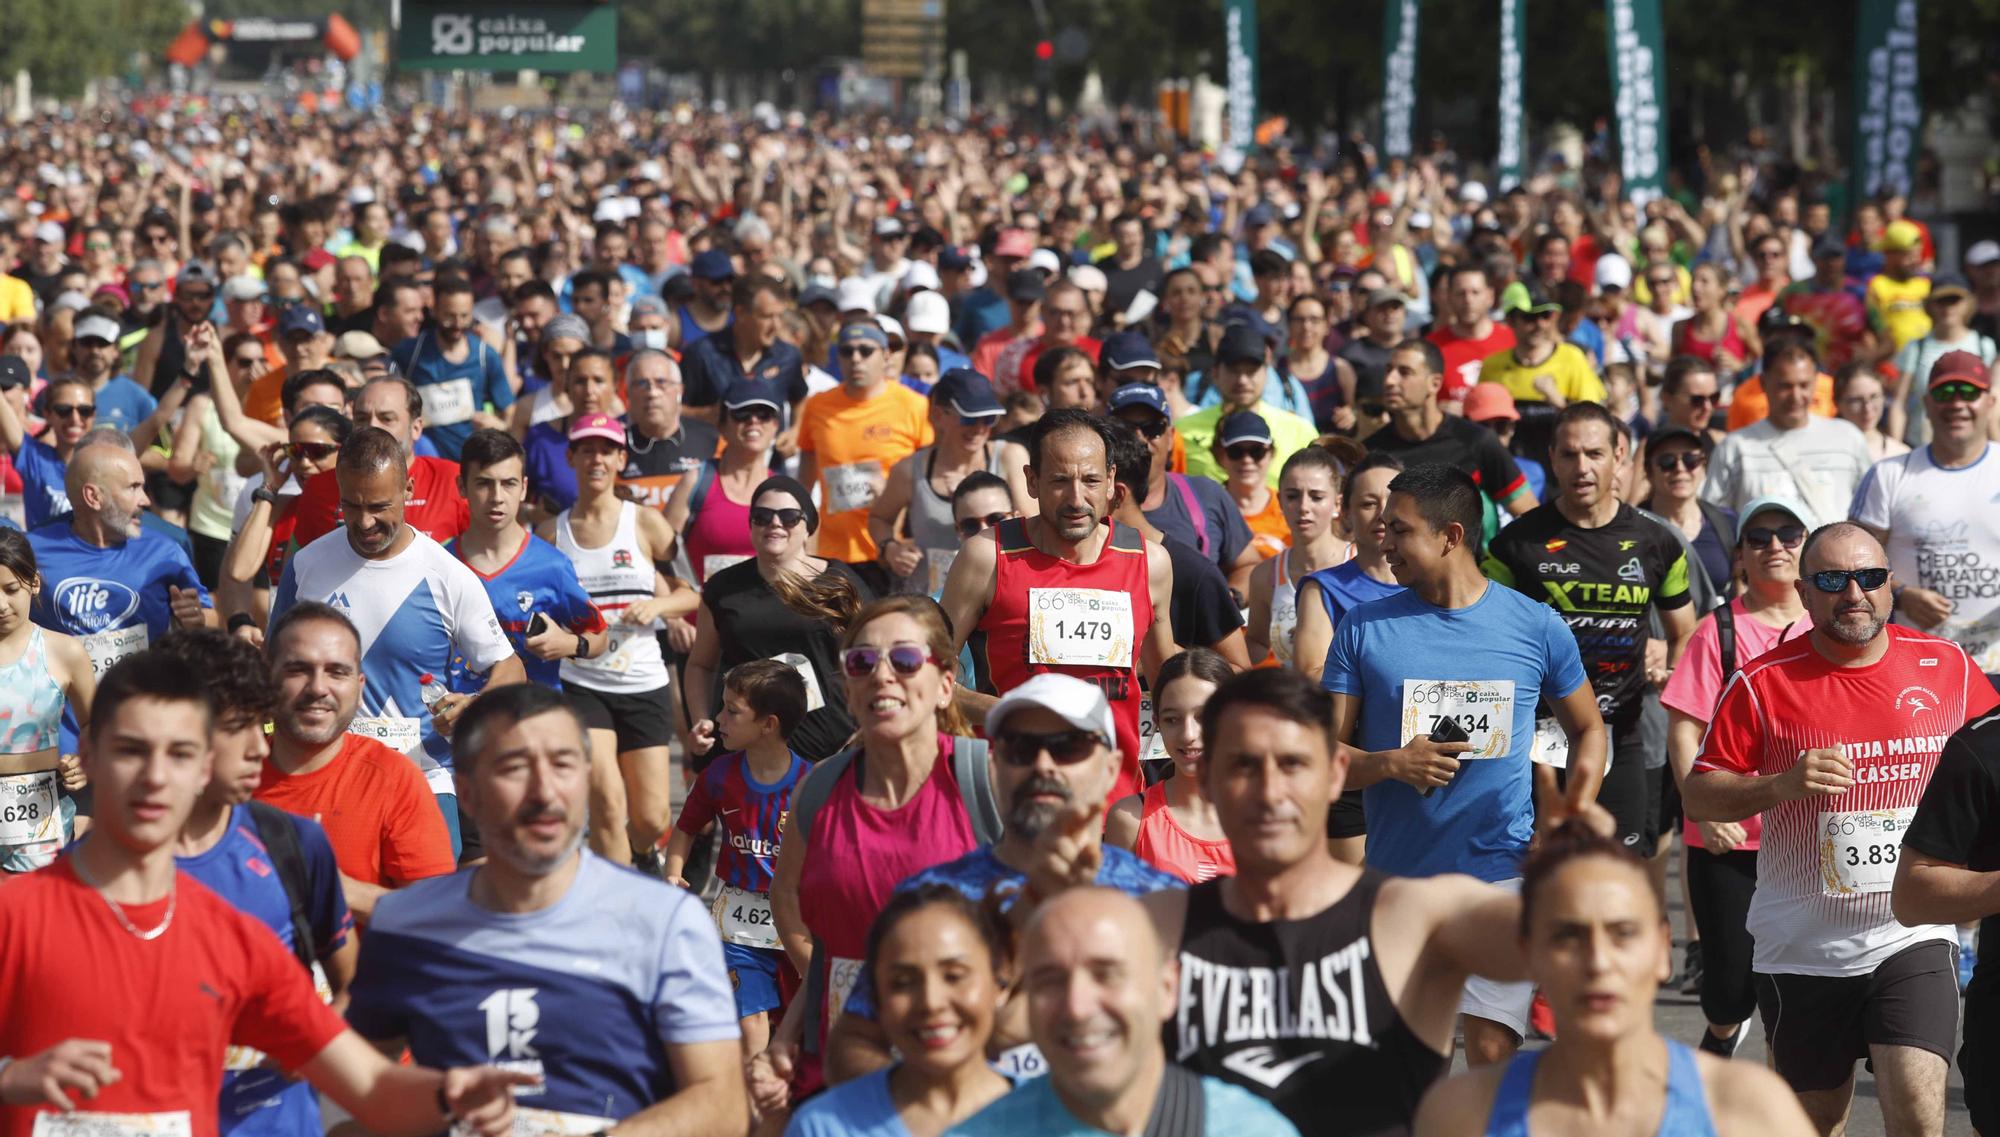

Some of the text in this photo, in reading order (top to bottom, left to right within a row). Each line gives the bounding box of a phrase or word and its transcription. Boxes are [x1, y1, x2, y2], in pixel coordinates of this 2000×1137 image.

[478, 16, 546, 33] caixa
[478, 32, 585, 54] popular
[1038, 592, 1064, 610] 66
[1055, 620, 1112, 641] 1.479
[1413, 684, 1440, 704] 66
[1429, 714, 1490, 733] 734
[1855, 763, 1922, 785] CÀSSER
[1827, 814, 1873, 835] 66 Volta
[1846, 844, 1902, 866] 3.83
[732, 906, 773, 926] 4.62
[1176, 935, 1371, 1063] EVERLAST
